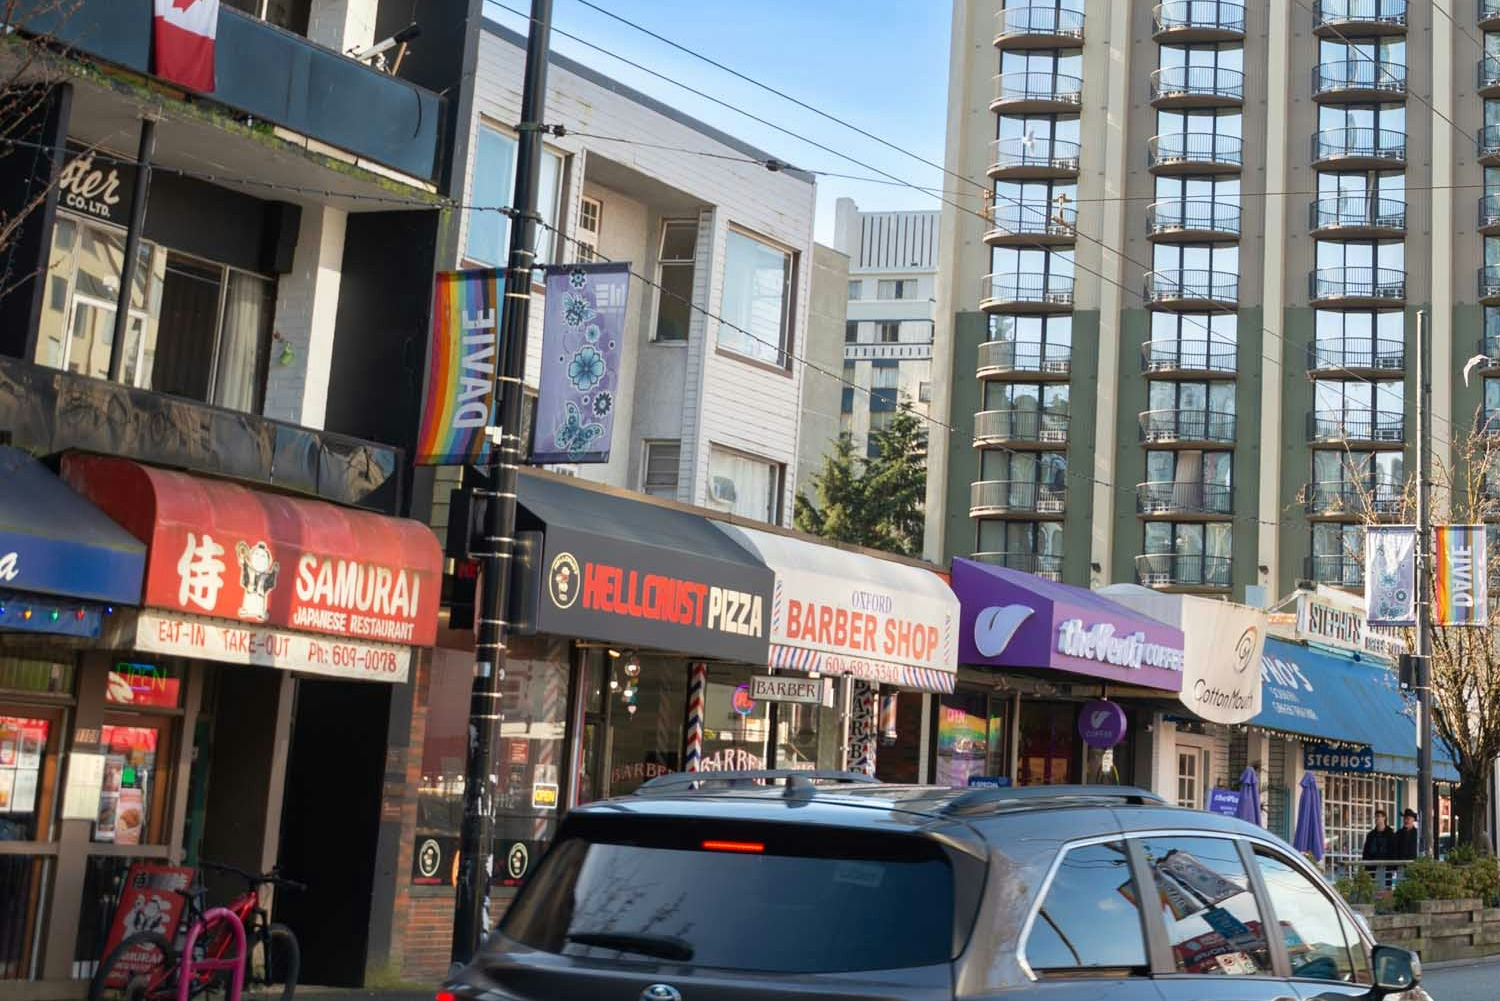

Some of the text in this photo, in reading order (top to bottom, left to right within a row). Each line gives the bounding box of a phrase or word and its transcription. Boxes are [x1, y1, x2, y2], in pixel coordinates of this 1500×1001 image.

[59, 150, 120, 204] ster
[177, 532, 226, 611] 侍
[296, 553, 421, 618] SAMURAI
[293, 606, 414, 641] JAPANESE RESTAURANT
[582, 562, 763, 639] HELLCRUST PIZZA
[852, 590, 893, 614] OXFORD
[158, 619, 206, 649] EAT-IN
[221, 629, 291, 659] TAKE-OUT
[308, 641, 329, 664] Ph:
[786, 599, 939, 662] BARBER SHOP
[755, 681, 817, 697] BARBER
[1307, 754, 1372, 768] STEPHO'S
